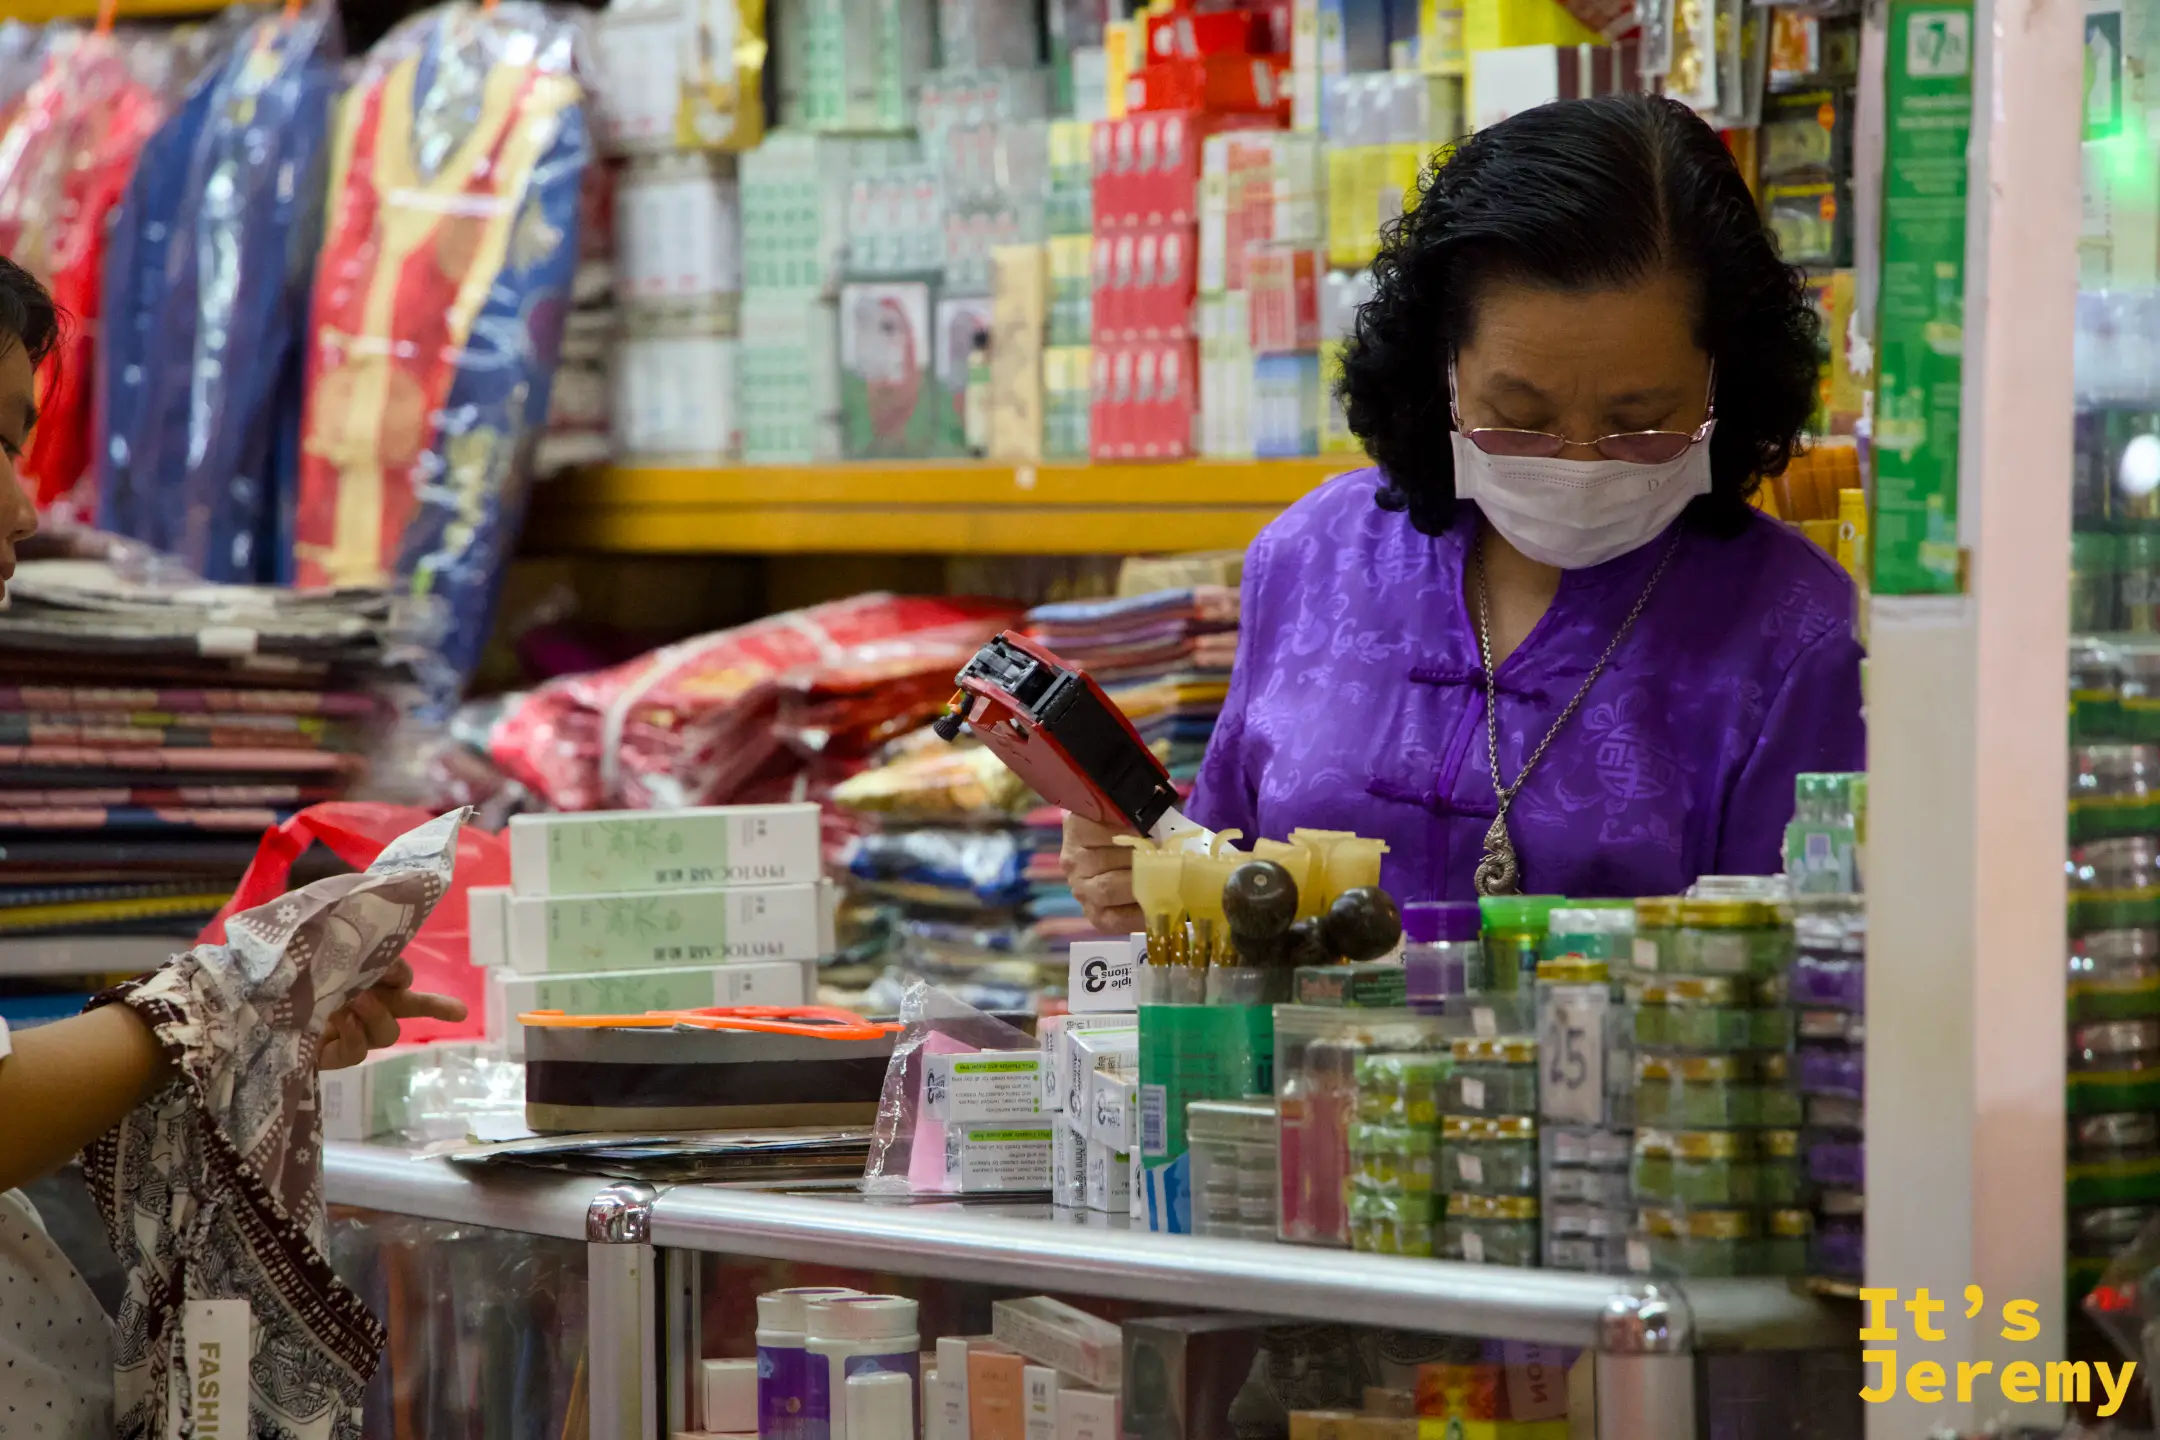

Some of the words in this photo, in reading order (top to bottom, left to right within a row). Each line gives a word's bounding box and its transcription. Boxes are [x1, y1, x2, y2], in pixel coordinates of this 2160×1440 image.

[1085, 960, 1108, 993] 3
[1101, 967, 1131, 979] tions
[1111, 977, 1131, 988] iple
[198, 1343, 220, 1440] FASHI
